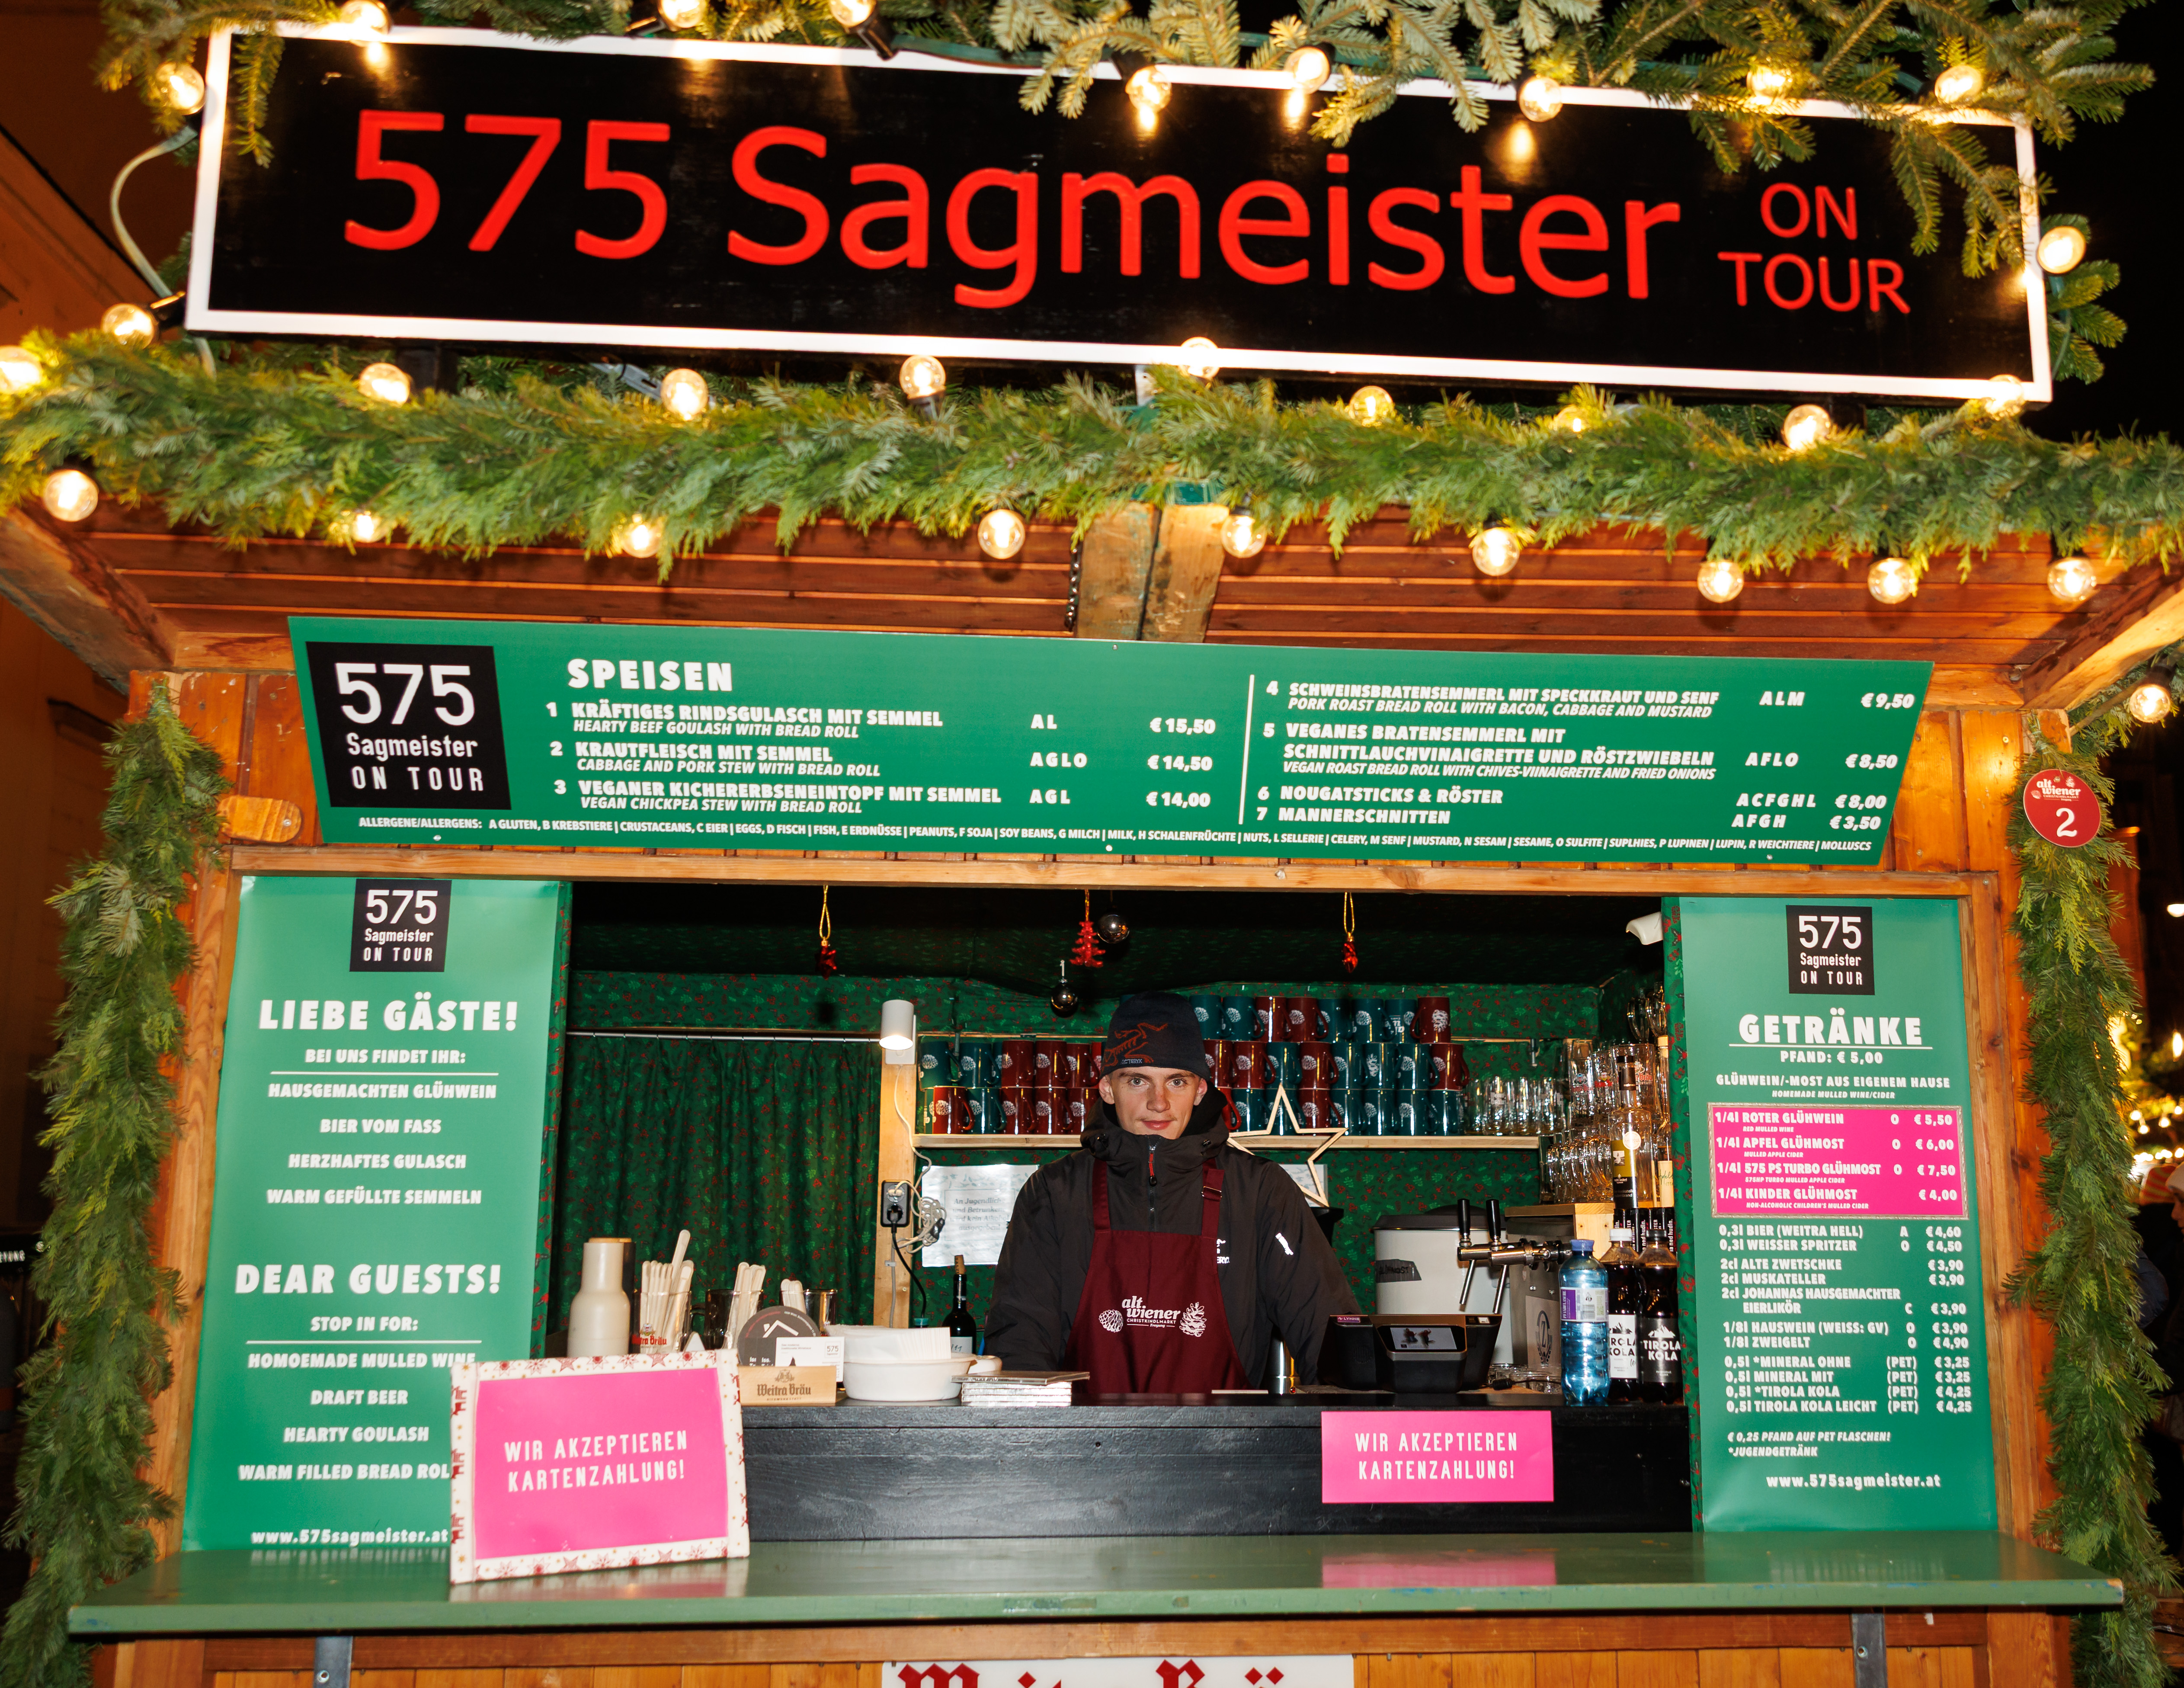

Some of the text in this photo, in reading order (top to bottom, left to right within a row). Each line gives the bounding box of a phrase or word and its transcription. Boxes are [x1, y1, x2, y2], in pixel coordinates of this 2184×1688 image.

[345, 109, 1681, 309] 575 Sagmeister
[1760, 183, 1857, 240] ON
[1717, 251, 1911, 314] TOUR
[567, 658, 733, 691] SPEISEN
[335, 663, 474, 726] 575
[1266, 680, 1720, 705] 4 SCHWEINSBRATENSEMMERL MIT SPECKKRAUT UND SENF
[546, 698, 943, 727] 1 KRÄFTIGES RINDSGULASCH MIT SEMMEL
[1287, 697, 1712, 718] PORK ROAST BREAD ROLL WITH BACON, CABBAGE AND MUSTARD
[573, 719, 859, 738] HEARTY BEEF GOULASH WITH BREAD ROLL
[1262, 722, 1566, 743] 5 VEGANES BRATENSEMMERL MIT
[346, 732, 478, 762] Sagmeister
[550, 741, 833, 762] 2 KRAUTFLEISCH MIT SEMMEL
[1283, 743, 1714, 766] SCHNITTLAUCHVINAIGRETTE UND RÖSTZWIEBELN
[577, 758, 881, 777] CABBAGE AND PORK STEW WITH BREAD ROLL
[352, 766, 484, 791] ON TOUR
[2037, 779, 2055, 789] alt.
[554, 779, 1002, 803] 3 VEGANER KICHERERBSENEINTOPF MIT SEMMEL
[1258, 785, 1503, 804] 6 NOUGATSTICKS & RÖSTER
[2042, 786, 2081, 796] wiener
[580, 796, 862, 813] VEGAN CHICKPEA STEW WITH BREAD ROLL
[359, 817, 483, 829] ALLERGENE/ALLERGENS:
[1257, 807, 1451, 824] 7 MANNERSCHNITTEN
[2056, 808, 2078, 838] 2
[366, 889, 438, 924] 575
[365, 928, 434, 945] Sagmeister
[1799, 915, 1861, 949] 575
[364, 947, 432, 962] ON TOUR
[1800, 952, 1861, 969] Sagmeister
[1801, 970, 1862, 985] ON TOUR
[258, 992, 518, 1031] LIEBE GÄSTE!
[1739, 1008, 1922, 1045] GETRÄNKE
[305, 1049, 466, 1064] BEI UNS FINDET IHR:
[1716, 1072, 1950, 1088] GLÜHWEIN/-MOST AUS EIGENEM HAUSE
[268, 1081, 496, 1099] HAUSGEMACHTEN GLÜHWEIN
[320, 1119, 442, 1134] BIER VOM FASS
[1742, 1112, 1780, 1123] ROTER
[1782, 1110, 1844, 1124] GLÜHWEIN
[288, 1154, 467, 1169] HERZHAFTES GULASCH
[266, 1185, 482, 1204] WARM GEFÜLLTE SEMMELN
[235, 1264, 501, 1295] DEAR GUESTS!
[1721, 1272, 1826, 1285] 2cl MUSKATELLER
[1121, 1296, 1146, 1309] alt.
[1743, 1299, 1801, 1314] EIERLIKÖR
[1126, 1308, 1181, 1320] wiener
[310, 1316, 419, 1332] STOP IN FOR:
[1643, 1340, 1681, 1351] TIROLA
[248, 1353, 358, 1369] HOMOEMADE
[362, 1353, 428, 1368] MULLED
[1648, 1350, 1678, 1361] KOLA
[310, 1390, 408, 1405] DRAFT BEER
[757, 1383, 811, 1396] Weitra Bräu
[283, 1426, 429, 1443] HEARTY GOULASH
[1355, 1432, 1517, 1452] WIR AKZEPTIEREN
[505, 1430, 687, 1462] WIR AKZEPTIEREN
[239, 1465, 293, 1480] WARM
[297, 1464, 353, 1480] FILLED
[357, 1463, 413, 1479] BREAD
[509, 1459, 684, 1492] KARTENZAHLUNG!
[1359, 1460, 1514, 1479] KARTENZAHLUNG!
[1766, 1472, 1941, 1491] www.575sagmeister.at
[251, 1527, 449, 1547] www.575sagmeister.at
